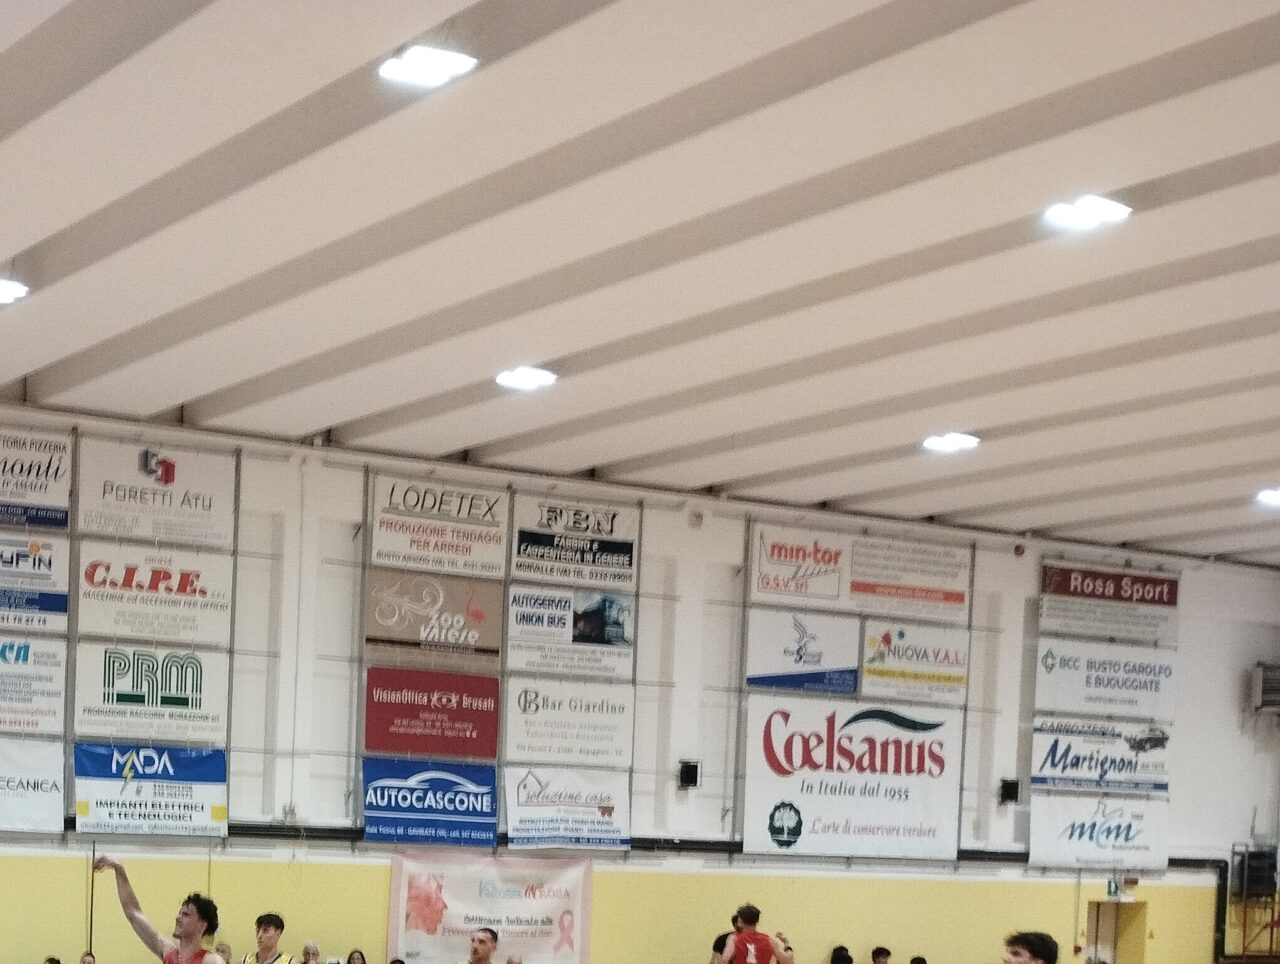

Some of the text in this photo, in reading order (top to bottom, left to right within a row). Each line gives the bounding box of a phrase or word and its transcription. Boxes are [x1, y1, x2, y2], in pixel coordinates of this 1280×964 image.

[29, 440, 67, 455] PIZZERIA
[102, 480, 174, 507] PORETTI
[388, 482, 501, 521] LODETEX
[379, 517, 502, 545] PRODUZIONE TENDAGGI
[409, 538, 472, 556] PER ARREDI
[520, 545, 631, 568] CARPENTERIA IN GENERE
[84, 559, 208, 598] C.I.P.E.
[1070, 571, 1169, 602] Rosa Sport
[515, 611, 567, 629] UNION BUS
[887, 645, 929, 663] NUOVA
[1059, 654, 1173, 679] BCC BUSTO GAROLFO
[103, 648, 203, 710] PRM
[1086, 674, 1161, 693] E BUGUGGIATE
[111, 748, 174, 776] MADA
[1039, 737, 1138, 780] Martignoni
[365, 787, 492, 814] AUTOCASCONE
[800, 777, 910, 802] In Italia dal 1955
[95, 799, 205, 812] IMPIANTI ELETTRICI
[118, 812, 193, 822] TECNOLOGICI
[746, 943, 759, 964] 1
